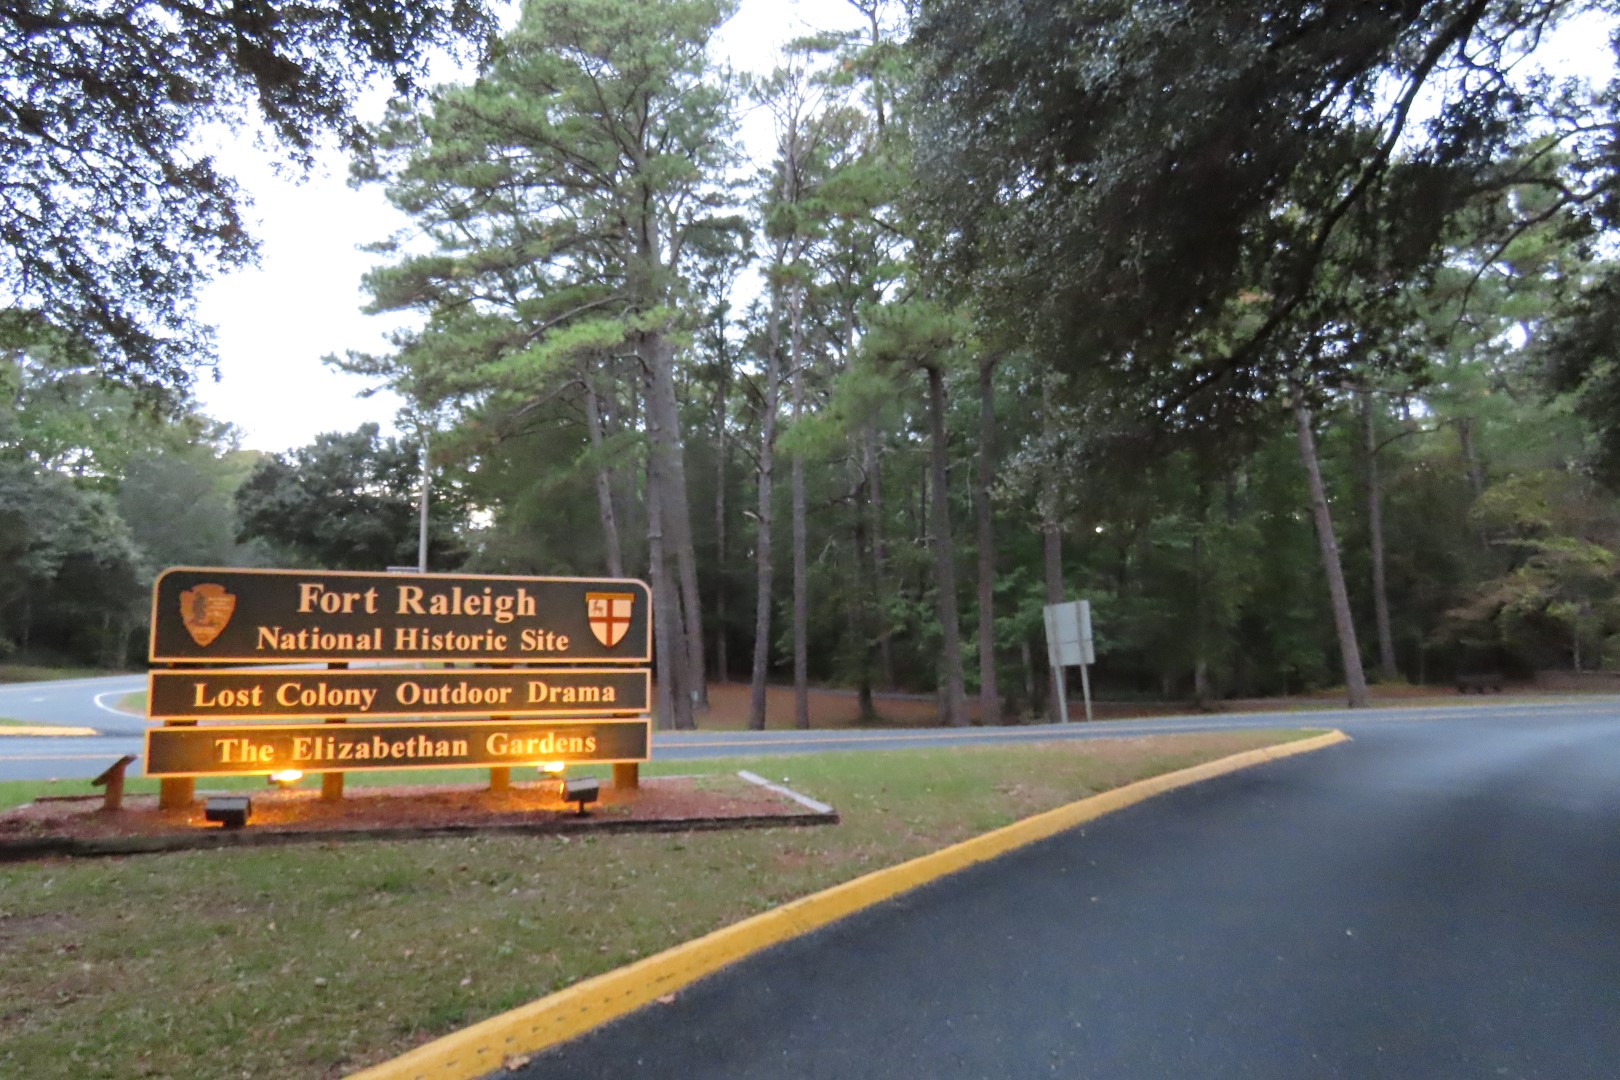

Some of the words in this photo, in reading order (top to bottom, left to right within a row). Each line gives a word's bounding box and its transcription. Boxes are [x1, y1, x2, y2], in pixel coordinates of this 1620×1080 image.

[297, 583, 379, 615] Fort
[397, 584, 537, 622] Raleigh
[256, 626, 382, 652] National
[394, 627, 507, 652] Historic
[520, 629, 569, 652] Site
[193, 683, 262, 708] Lost
[276, 682, 377, 712] Colony
[395, 681, 512, 706] Outdoor
[527, 682, 616, 704] Drama
[216, 738, 274, 763] The
[292, 735, 468, 760] Elizabethan
[486, 732, 597, 755] Gardens
